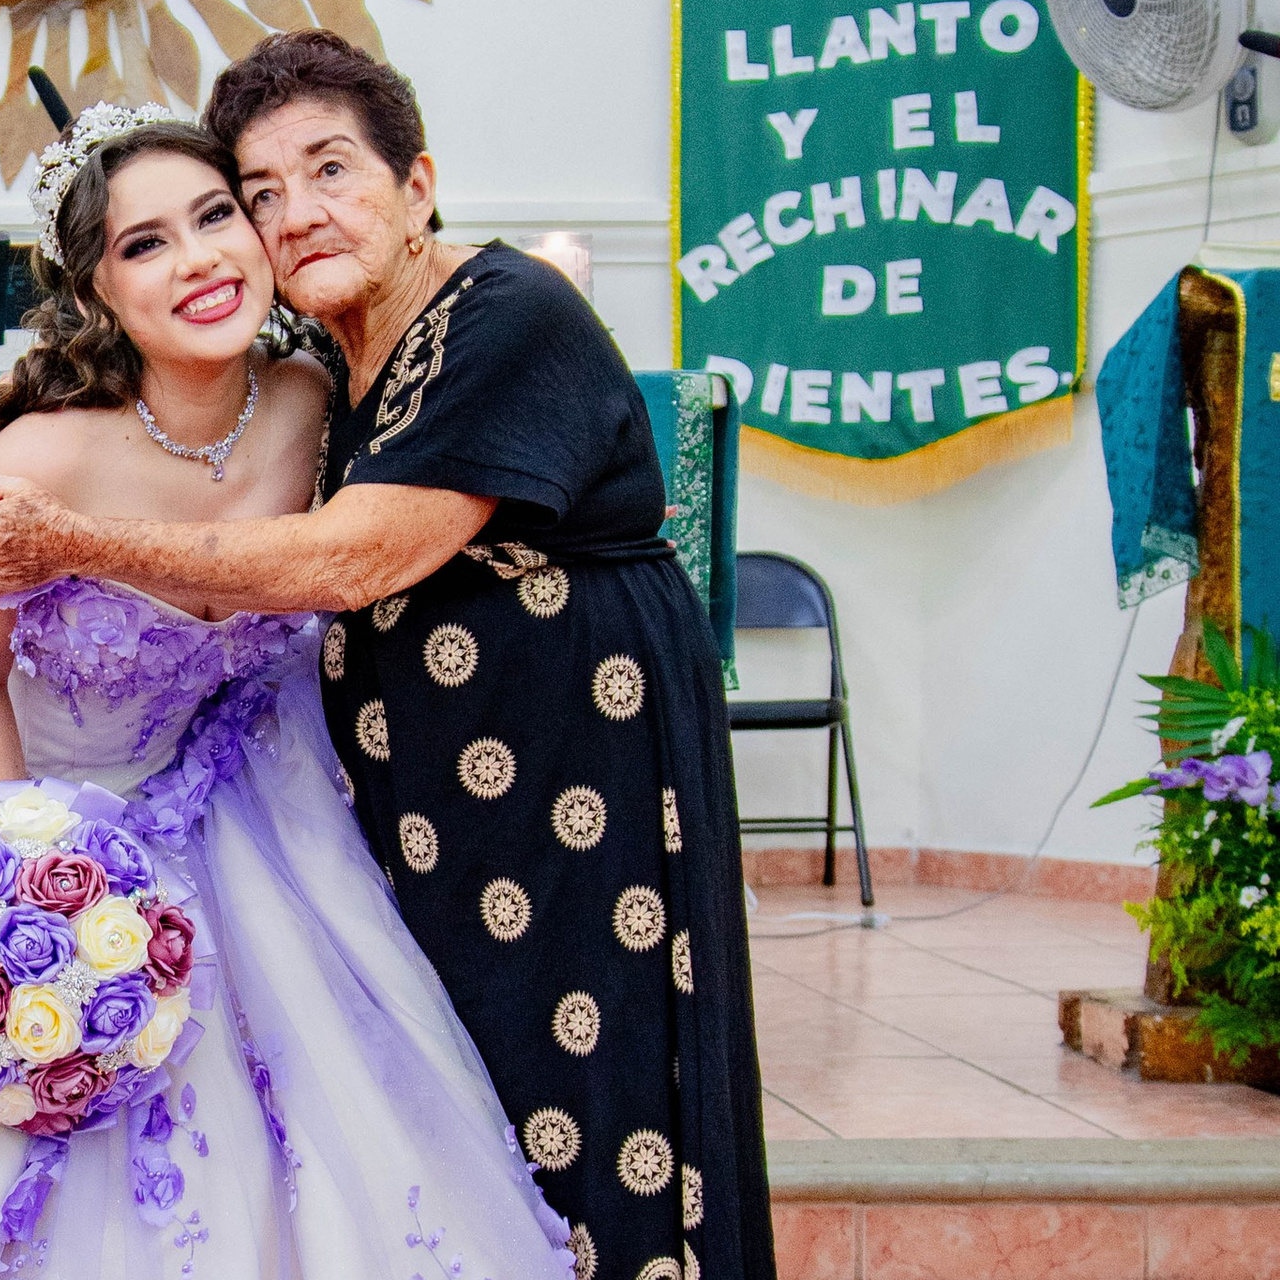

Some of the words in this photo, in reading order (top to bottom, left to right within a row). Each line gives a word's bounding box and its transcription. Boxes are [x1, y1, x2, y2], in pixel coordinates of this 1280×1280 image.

[767, 108, 818, 160] Y
[892, 90, 1001, 149] EL
[677, 168, 1077, 303] RECHINAR
[821, 258, 923, 316] DE
